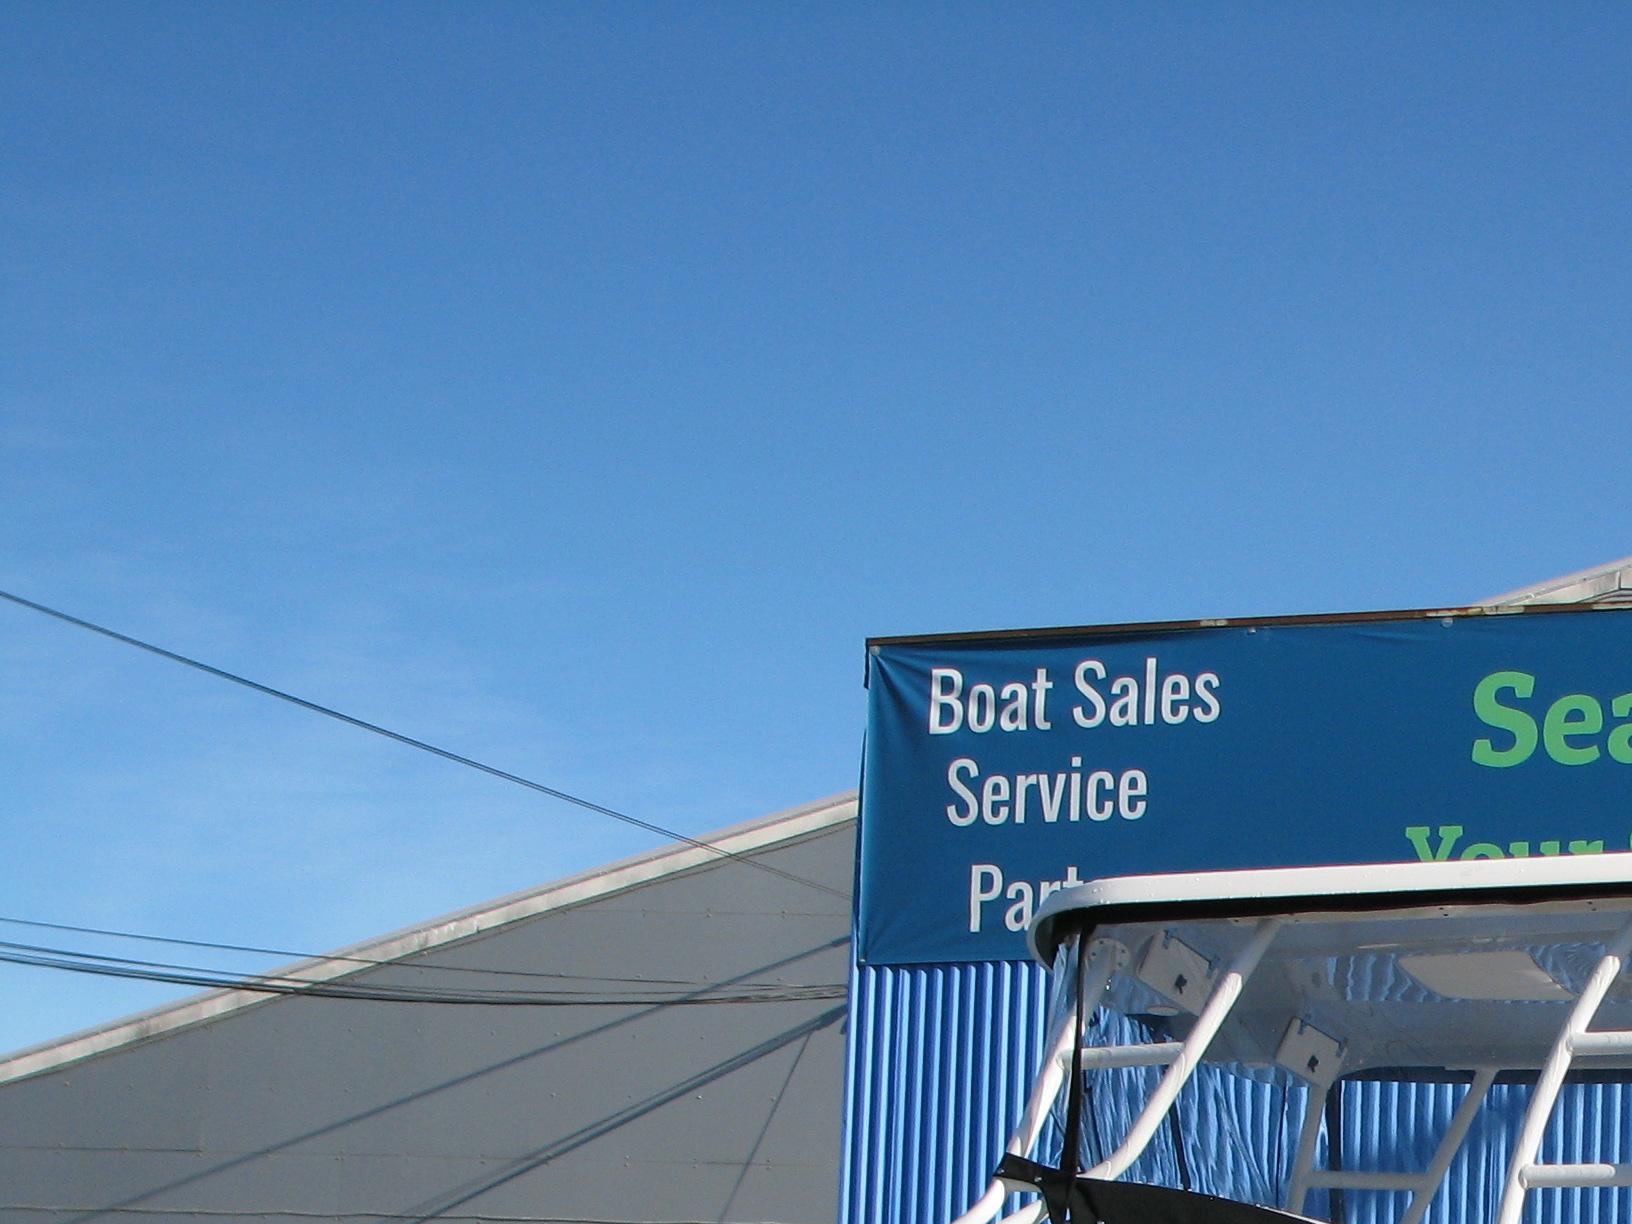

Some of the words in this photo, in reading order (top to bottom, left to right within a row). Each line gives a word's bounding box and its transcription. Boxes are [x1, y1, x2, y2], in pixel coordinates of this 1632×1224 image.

[927, 664, 1053, 735] Boat
[1073, 656, 1221, 728] Sales
[946, 755, 1148, 827] Service
